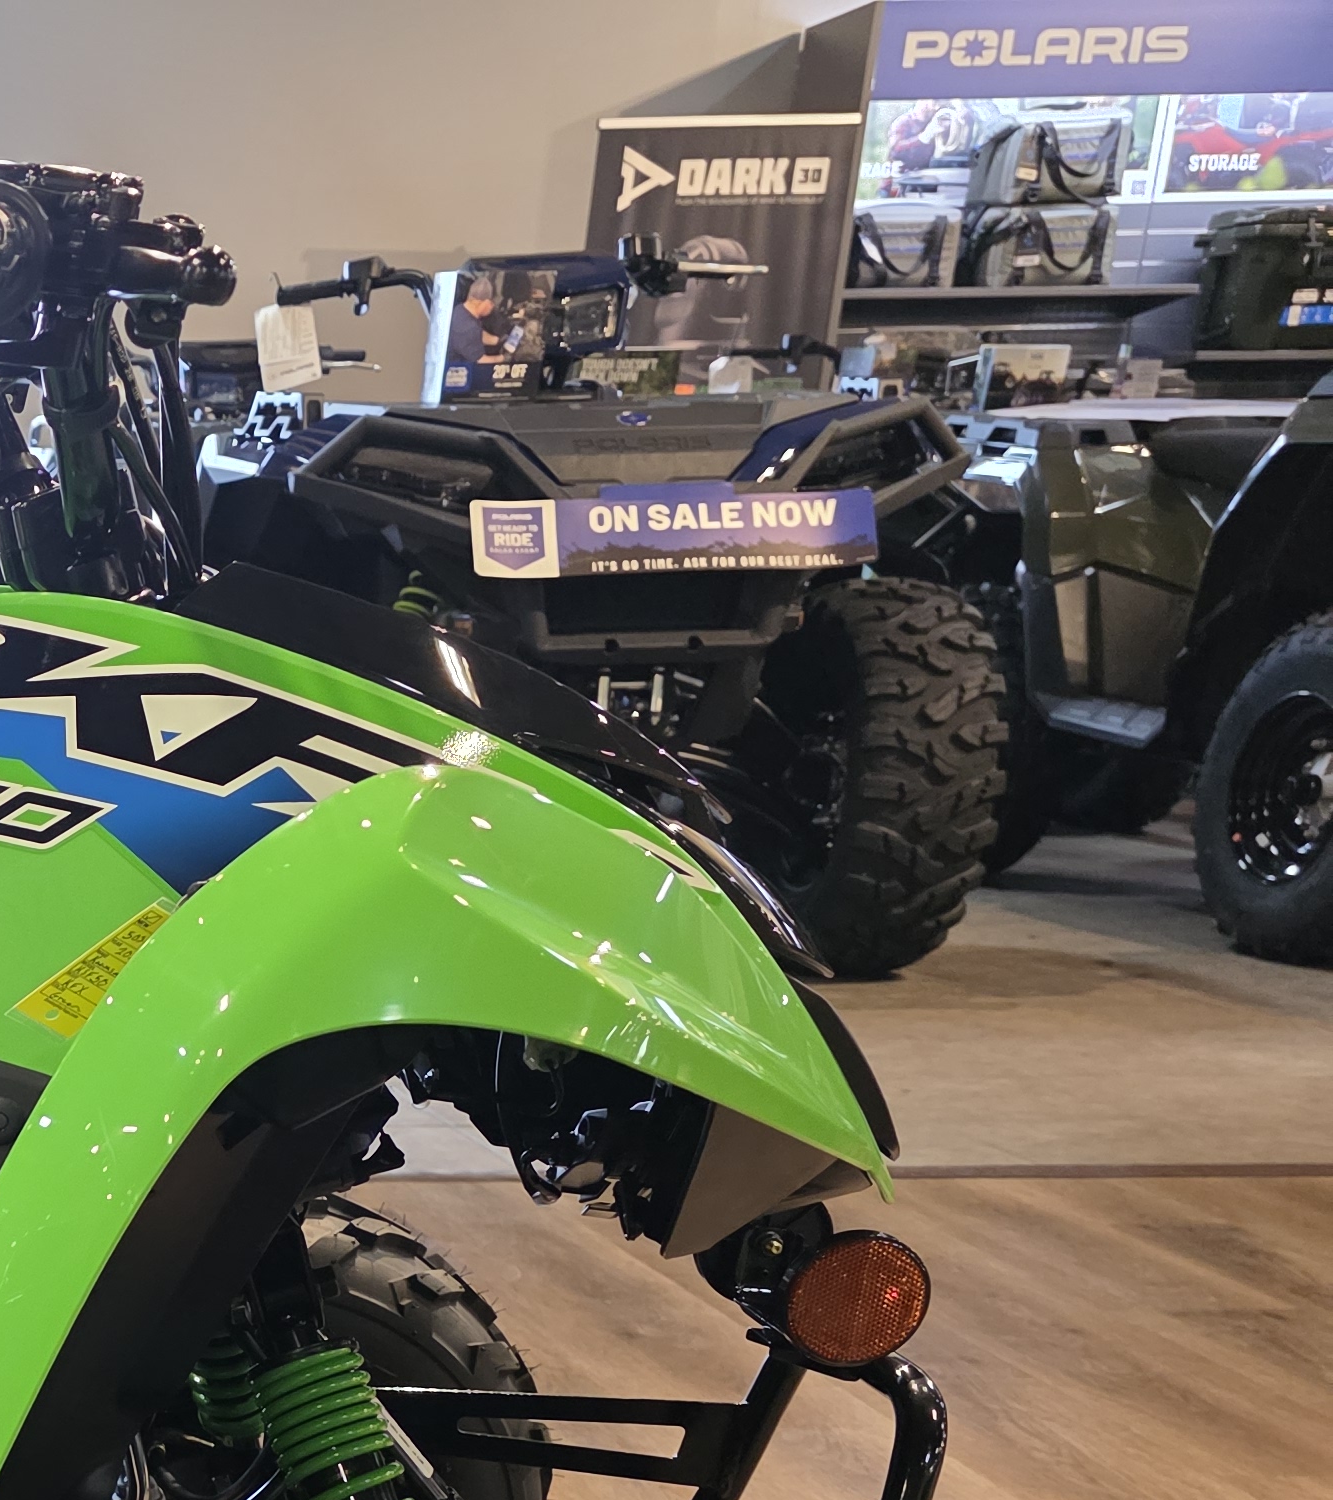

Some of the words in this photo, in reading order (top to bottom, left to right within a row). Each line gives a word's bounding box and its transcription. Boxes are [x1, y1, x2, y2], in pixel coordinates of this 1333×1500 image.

[902, 26, 1190, 69] POLARIS
[859, 160, 904, 178] RAGE
[1188, 153, 1261, 172] STORAGE
[677, 157, 790, 196] DARK
[588, 505, 640, 533] ON
[647, 502, 744, 531] SALE
[751, 498, 837, 528] NOW
[493, 533, 533, 547] RIDE
[591, 560, 618, 573] IT'S
[622, 559, 640, 571] GO
[643, 557, 679, 570] TIME.
[683, 556, 708, 568] ASK
[711, 555, 736, 568] FOR
[740, 555, 765, 567] OUR
[769, 555, 800, 567] BEST
[805, 553, 844, 566] DEAL.
